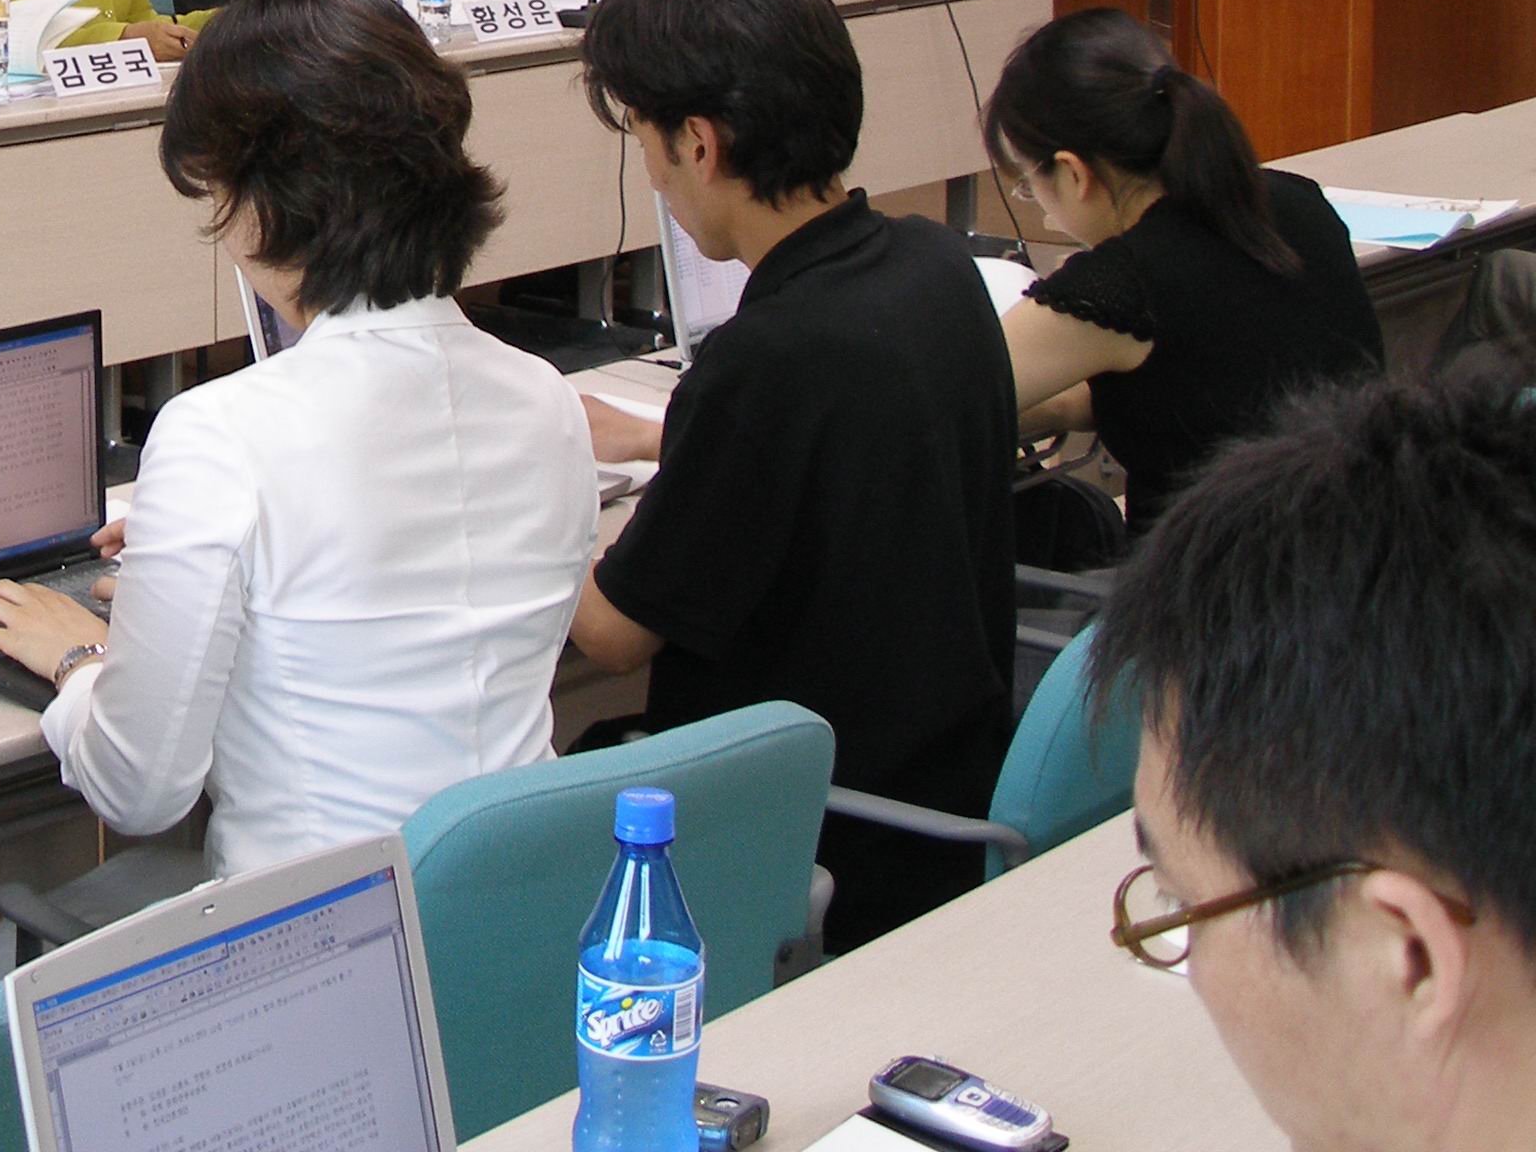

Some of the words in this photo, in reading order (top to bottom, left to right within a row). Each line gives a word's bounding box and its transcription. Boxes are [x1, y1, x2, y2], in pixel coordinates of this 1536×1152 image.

[471, 0, 553, 33] 황성운
[53, 49, 152, 88] 김봉국
[587, 997, 662, 1050] Sprite
